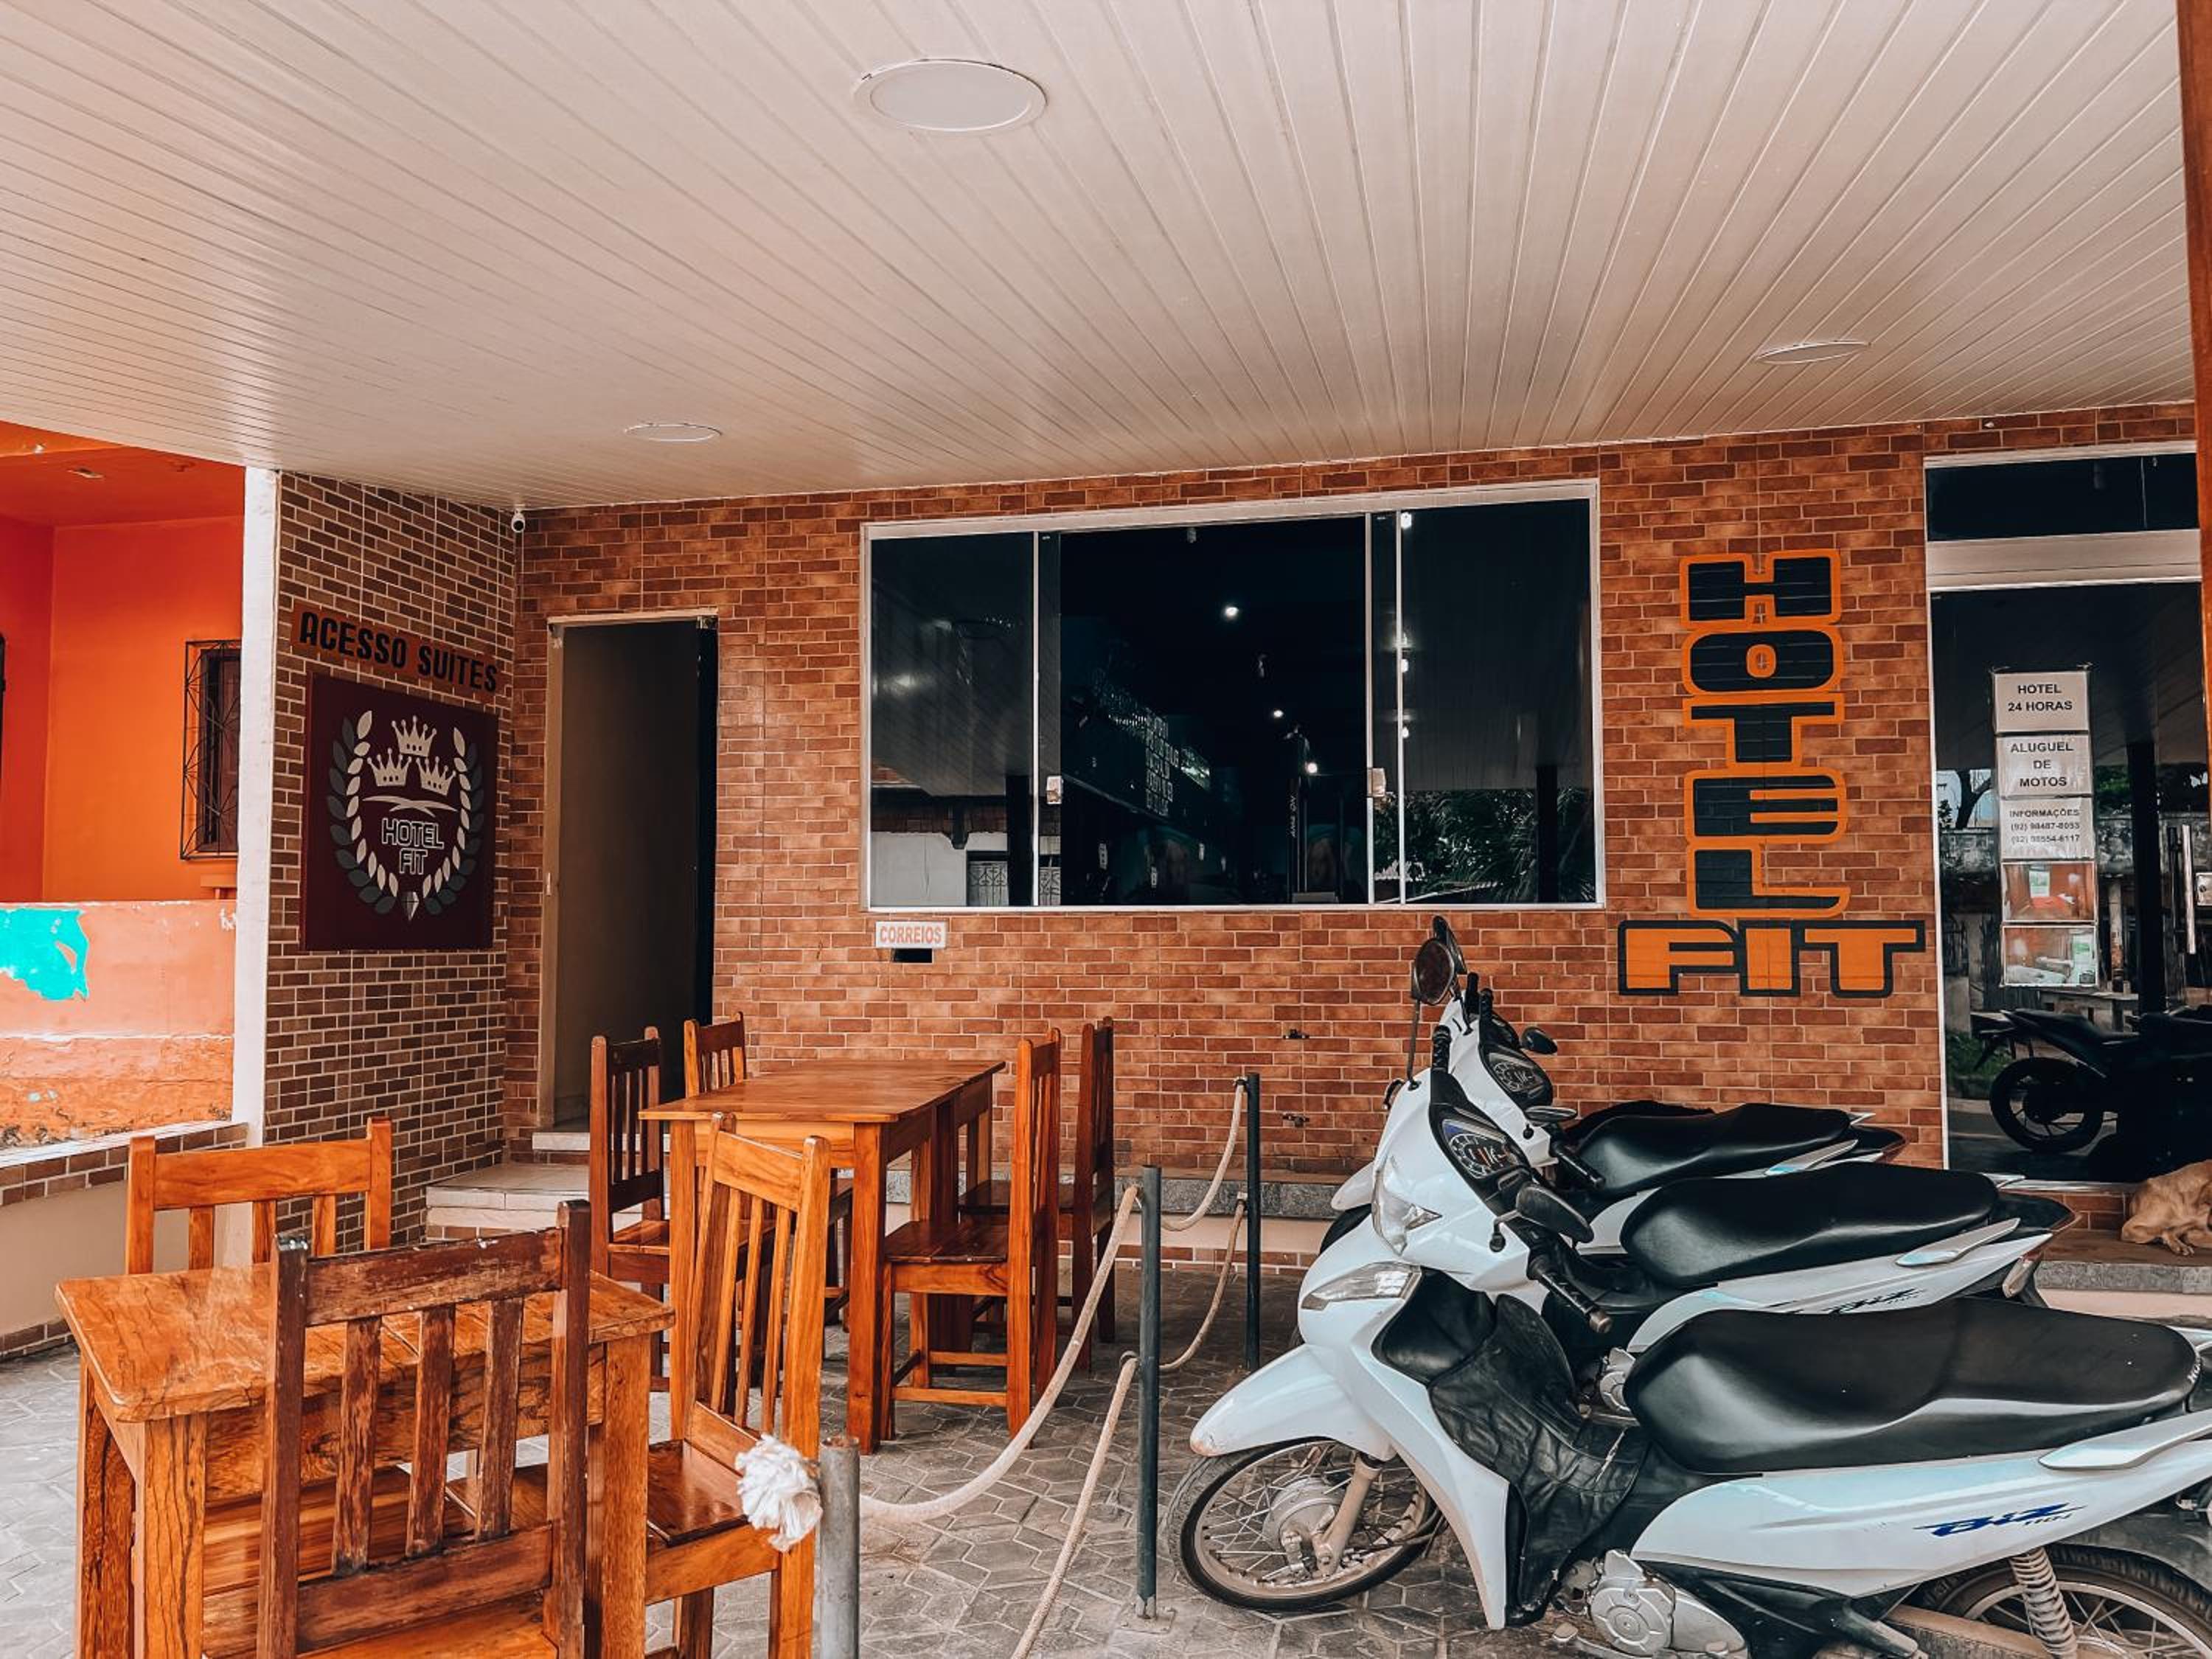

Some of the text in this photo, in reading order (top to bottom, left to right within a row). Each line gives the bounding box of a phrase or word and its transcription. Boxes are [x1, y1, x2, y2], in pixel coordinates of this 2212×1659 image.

[299, 611, 407, 669] ACESSO
[2018, 684, 2062, 694] HOTEL
[2008, 700, 2073, 712] 24 HORAS
[1680, 549, 1850, 919] HOTEL
[2011, 741, 2074, 753] ALUGUEL
[2033, 760, 2051, 769] DE
[2020, 776, 2067, 787] MOTOS
[381, 817, 445, 849] HOTEL
[399, 847, 428, 875] FIT
[880, 925, 942, 943] CORREIOS
[1618, 919, 1925, 998] FIT
